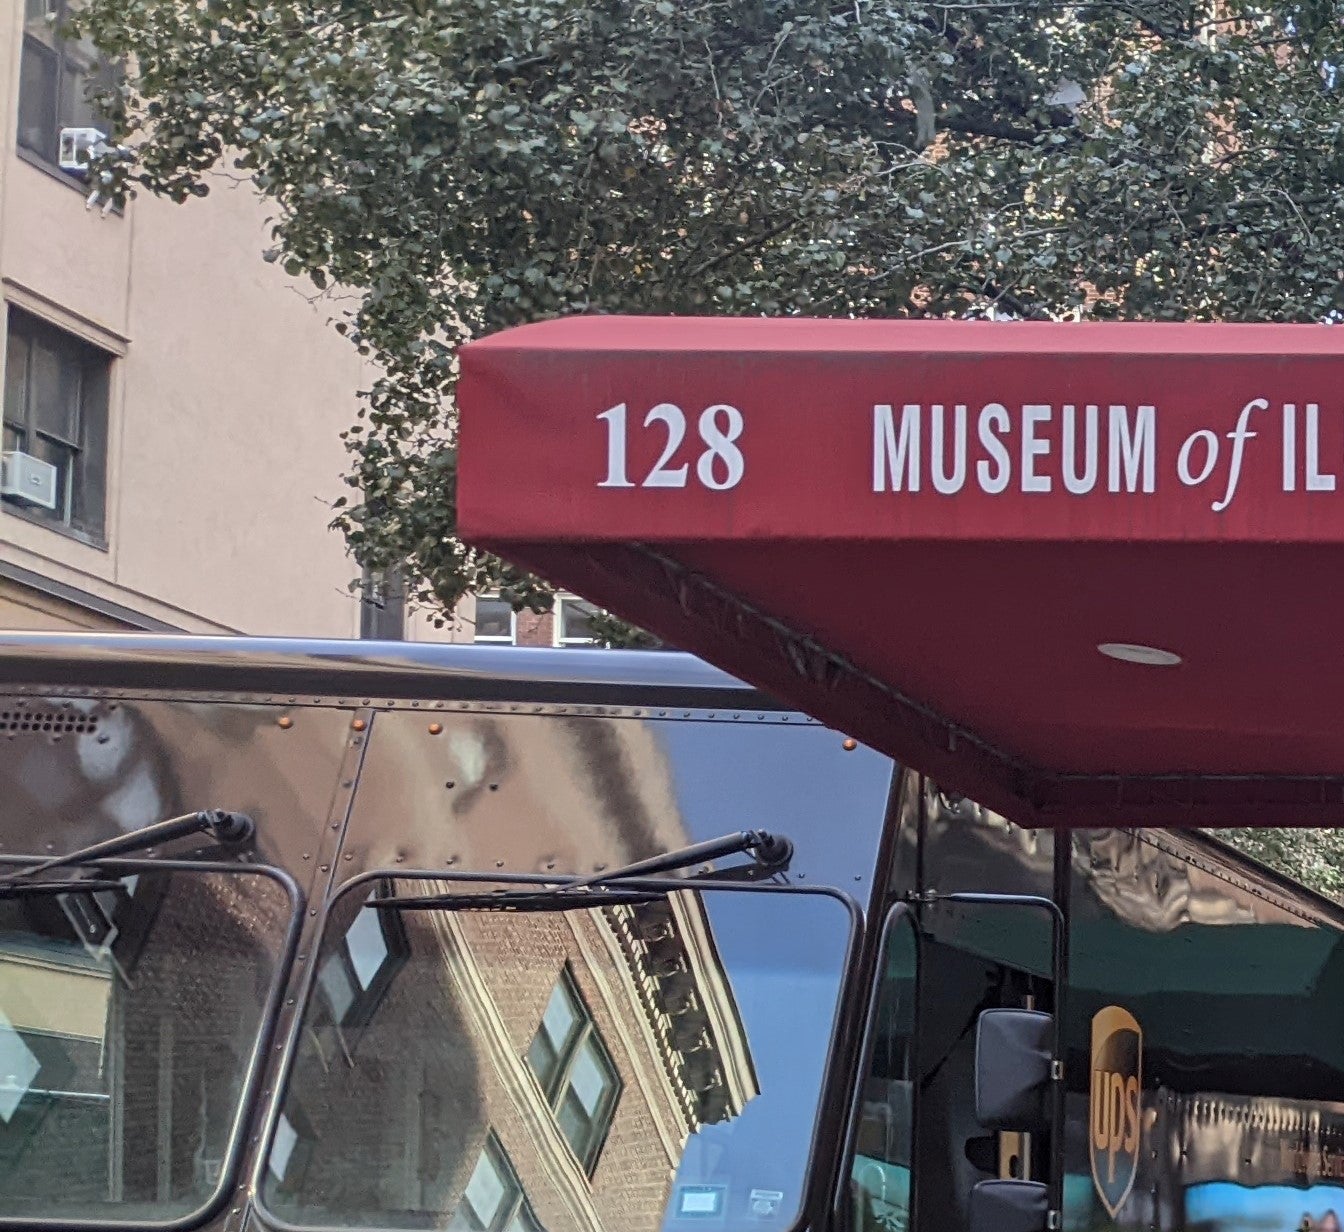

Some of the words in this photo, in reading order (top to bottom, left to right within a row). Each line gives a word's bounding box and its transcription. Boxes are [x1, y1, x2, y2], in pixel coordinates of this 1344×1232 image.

[595, 402, 745, 490] 128
[872, 403, 1156, 494] MUSEUM
[1176, 398, 1268, 512] of
